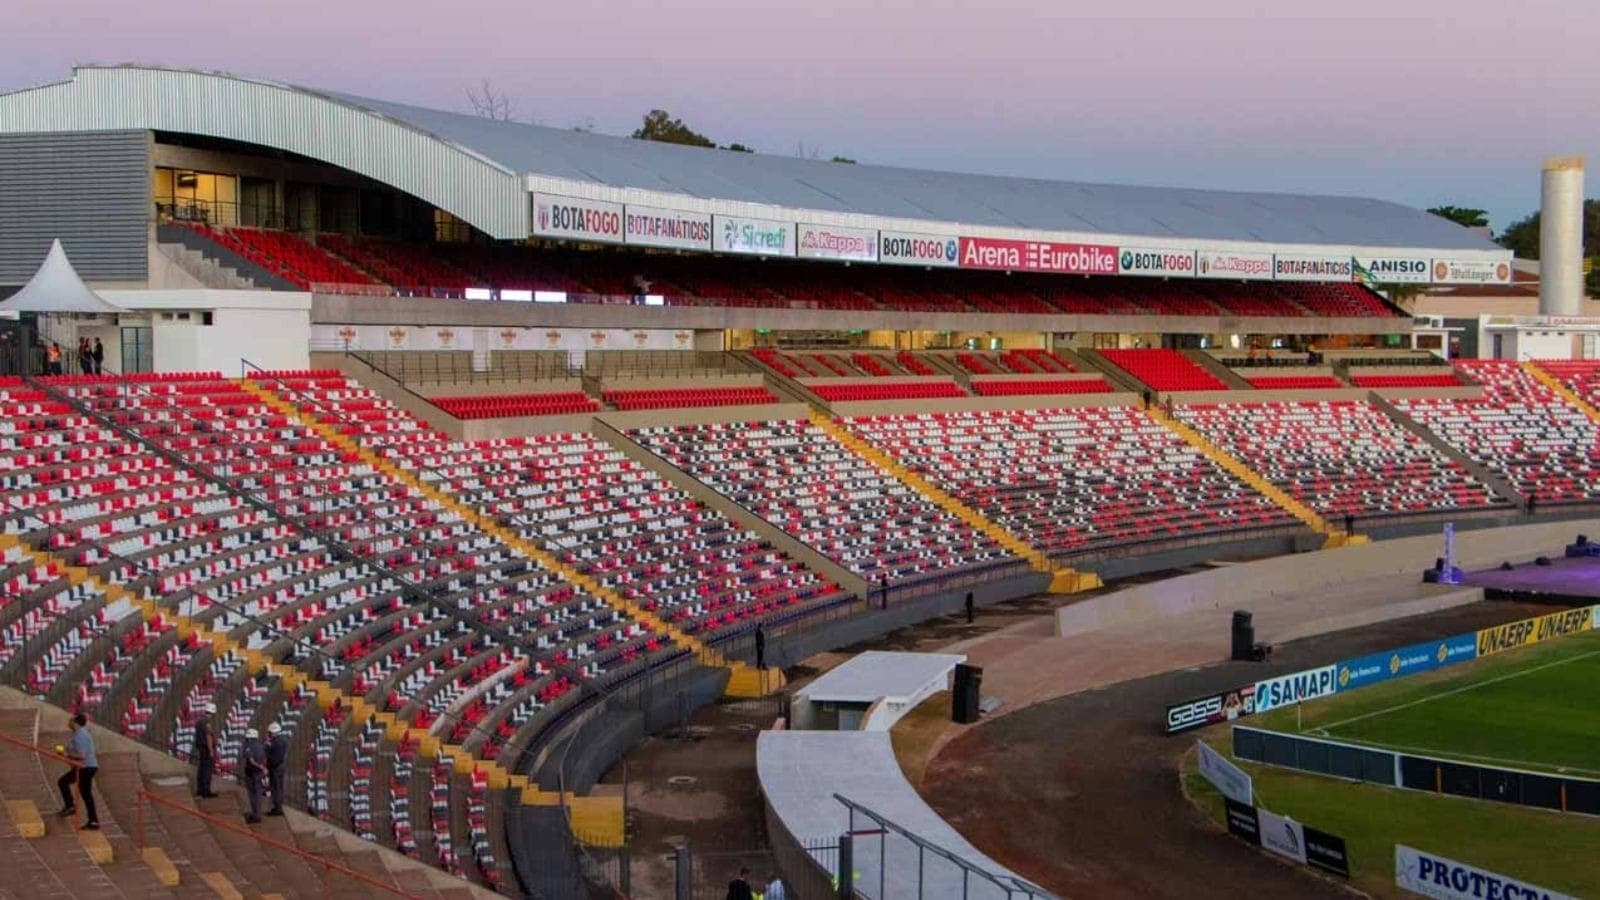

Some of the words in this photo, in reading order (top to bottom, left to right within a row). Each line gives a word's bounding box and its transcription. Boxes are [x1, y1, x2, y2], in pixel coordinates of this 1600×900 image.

[552, 205, 620, 235] BOTAFOGO
[627, 214, 710, 241] BOTAFANÁTICOS
[742, 224, 787, 249] Sicredi
[818, 231, 866, 255] Kappa
[883, 238, 943, 259] BOTAFOGO
[964, 239, 1020, 267] Arena
[1038, 244, 1114, 271] Eurobike
[1135, 253, 1192, 271] BOTAFOGO
[1228, 256, 1271, 273] Kappa
[1277, 258, 1350, 276] BOTAFANÁTICOS
[1369, 260, 1426, 273] ANISIO
[1479, 620, 1534, 656] UNAERP
[1537, 609, 1591, 641] UNAERP
[1271, 668, 1335, 706] SAMAPI
